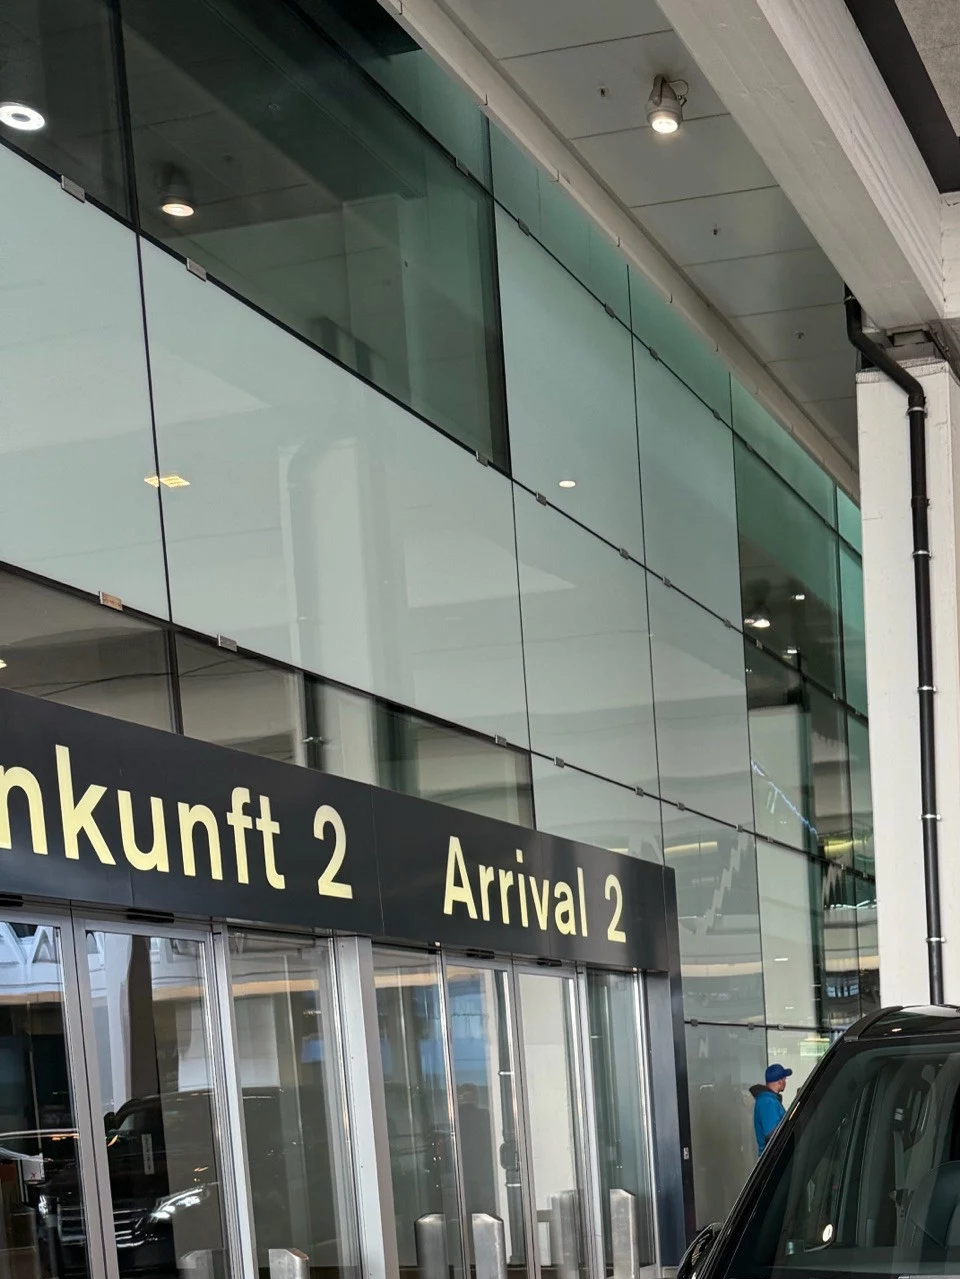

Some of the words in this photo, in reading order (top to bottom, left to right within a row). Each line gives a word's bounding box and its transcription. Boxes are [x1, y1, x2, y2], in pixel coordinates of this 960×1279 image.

[0, 744, 286, 890] nkunft
[313, 804, 353, 899] 2
[443, 835, 588, 938] Arrival
[604, 873, 627, 944] 2
